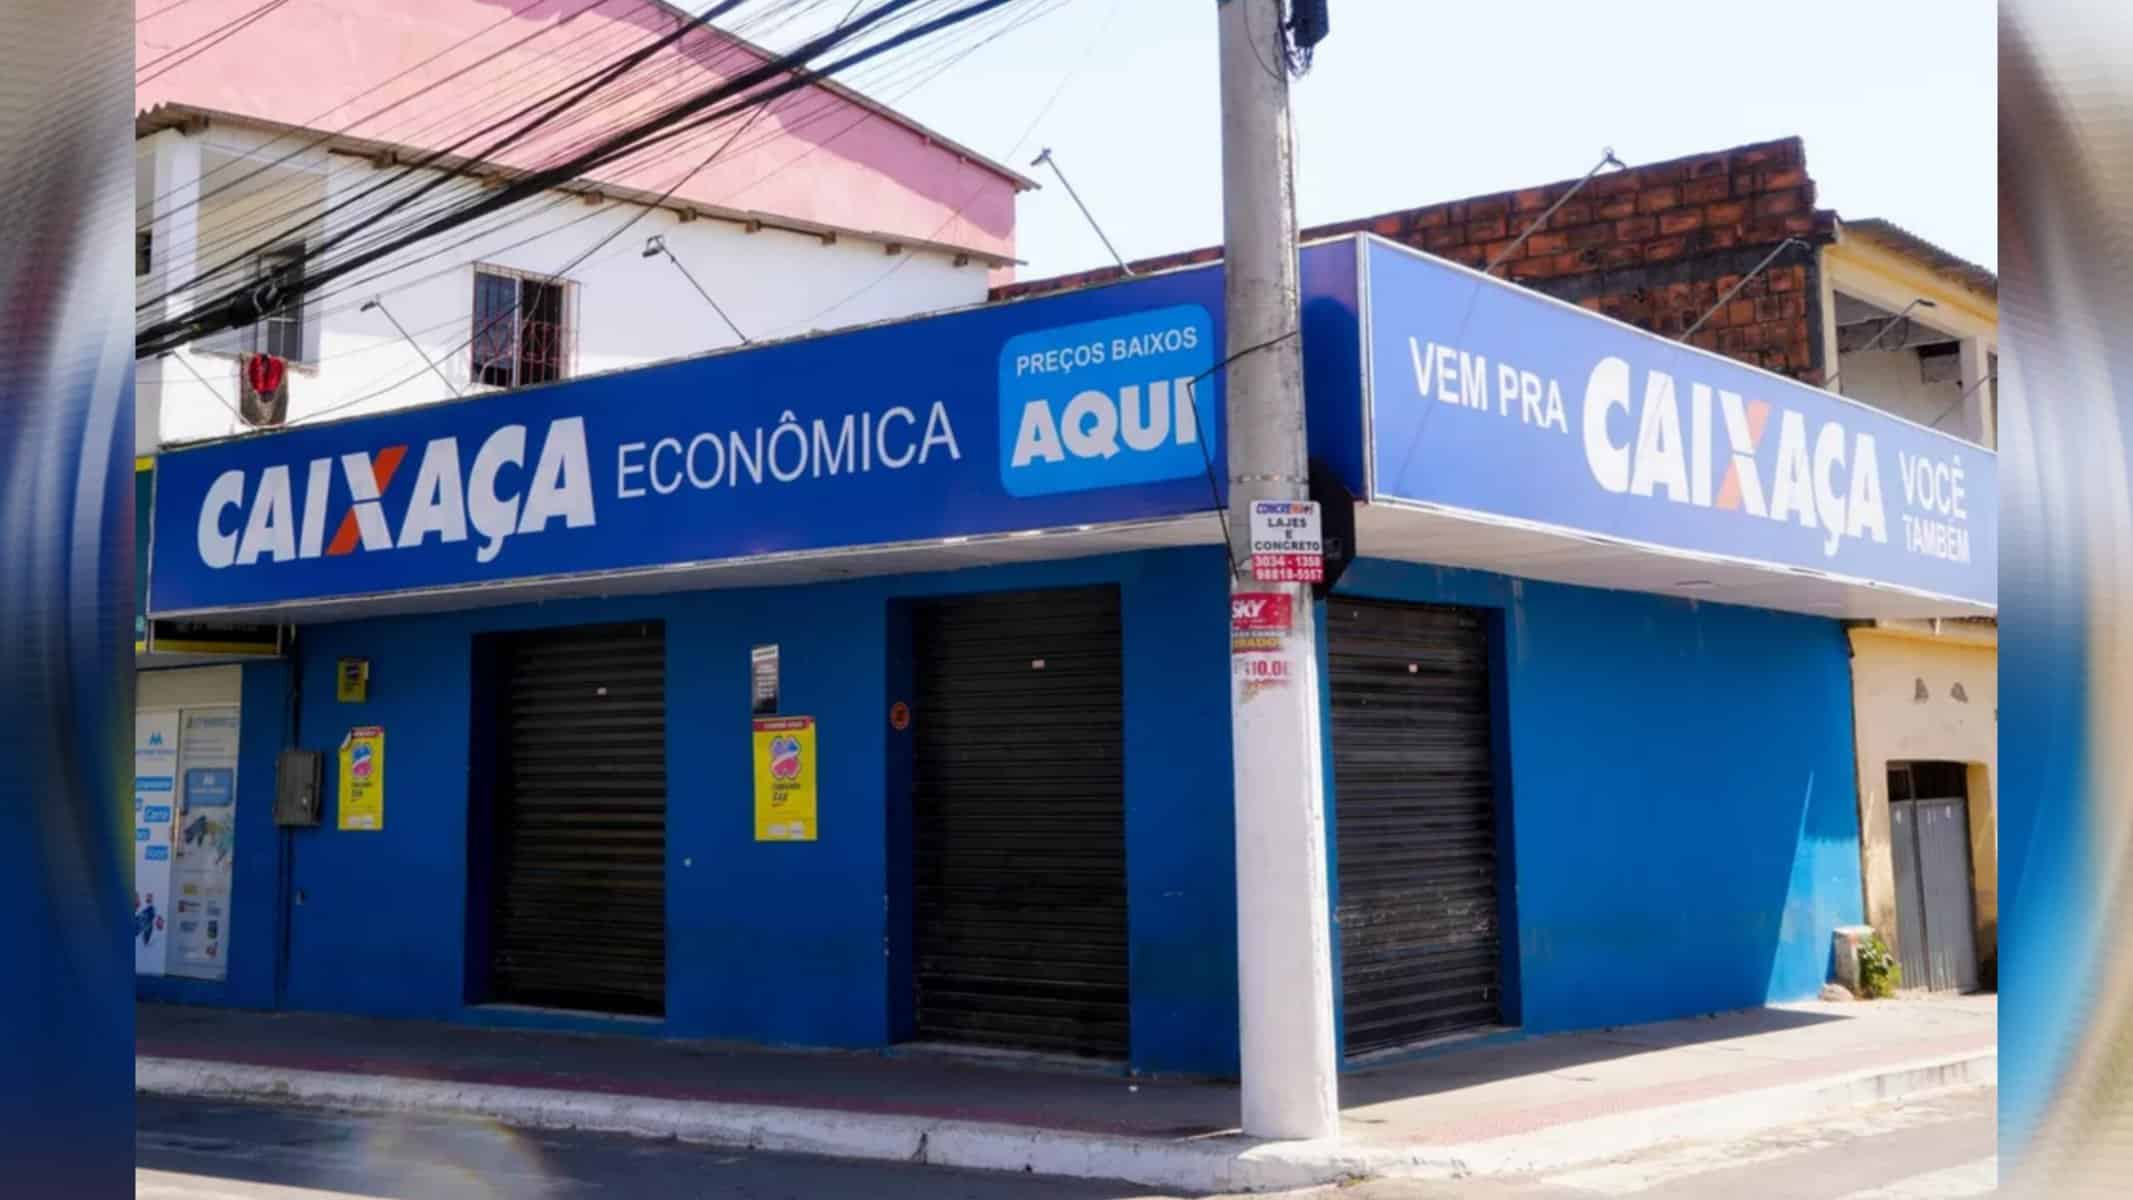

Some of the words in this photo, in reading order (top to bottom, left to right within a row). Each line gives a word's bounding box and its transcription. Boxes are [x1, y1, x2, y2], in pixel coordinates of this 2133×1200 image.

[1017, 343, 1104, 376] PREÇOS
[1112, 327, 1197, 360] BAIXOS
[1410, 338, 1487, 410] VEM
[1499, 364, 1567, 432] PRA
[1011, 376, 1197, 467] AQUI
[1583, 357, 1887, 556] CAIXAÇA
[198, 415, 596, 569] CAIXAÇA
[617, 401, 960, 499] ECONÔMICA
[1899, 452, 1967, 520] VOCÊ
[1254, 541, 1320, 551] CONCRETO
[1267, 518, 1307, 528] LAJES
[1285, 529, 1293, 539] E
[1903, 513, 1970, 564] TAMBÉM
[1231, 599, 1266, 618] SKY
